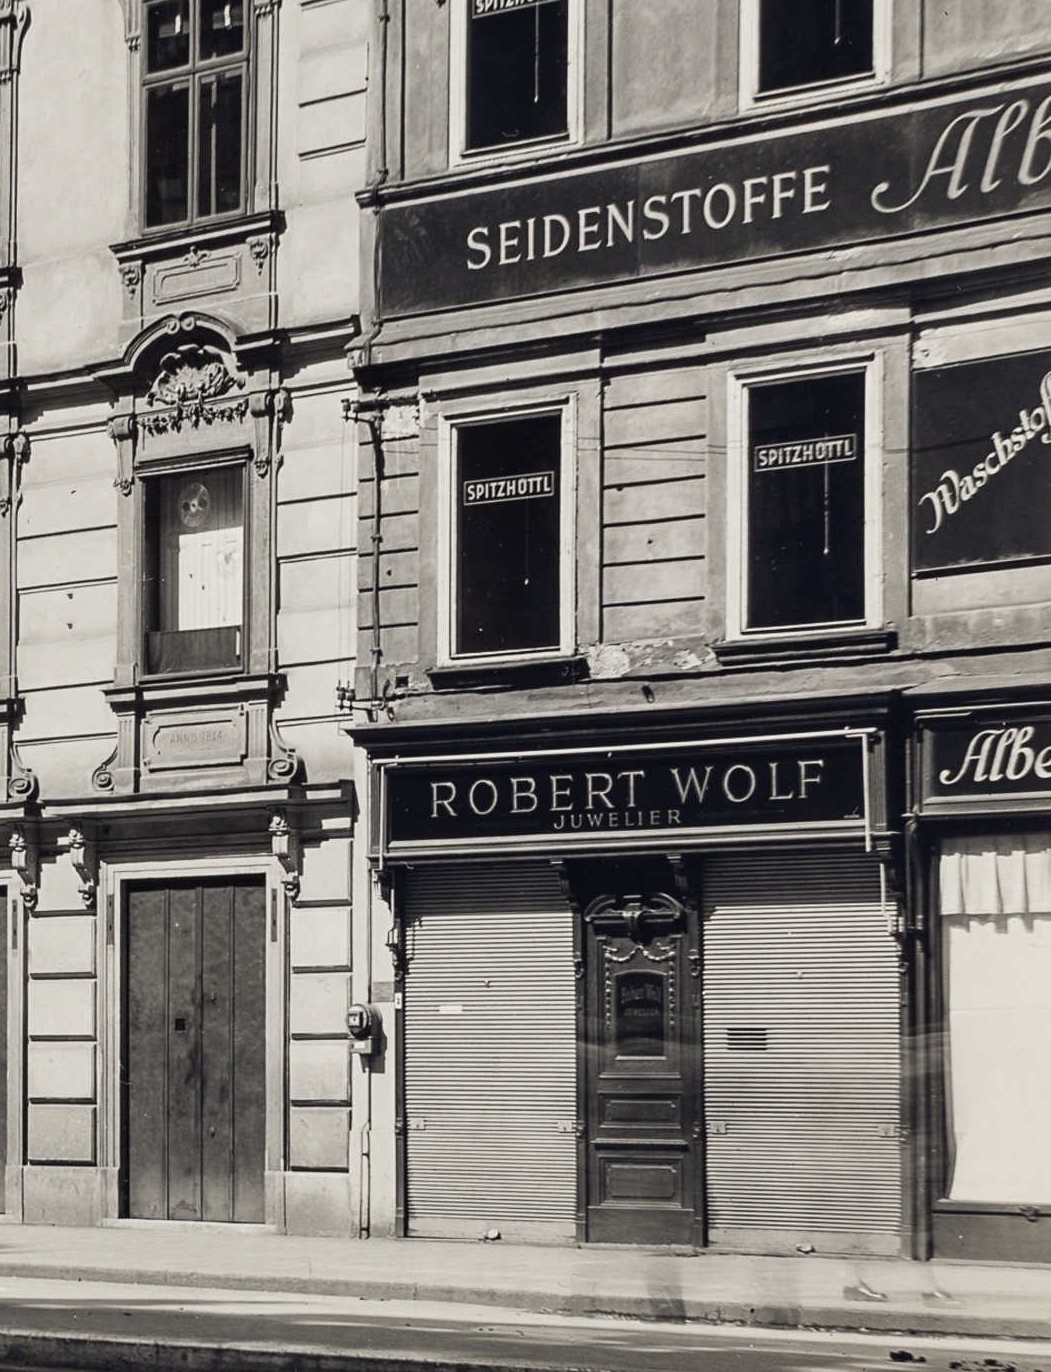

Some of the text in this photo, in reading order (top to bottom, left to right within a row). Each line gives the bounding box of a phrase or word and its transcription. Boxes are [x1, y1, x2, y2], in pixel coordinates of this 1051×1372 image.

[465, 164, 832, 271] SEIDENSTOFFE
[429, 759, 825, 818] ROBERT WOLF
[553, 809, 682, 830] JUWELIER
